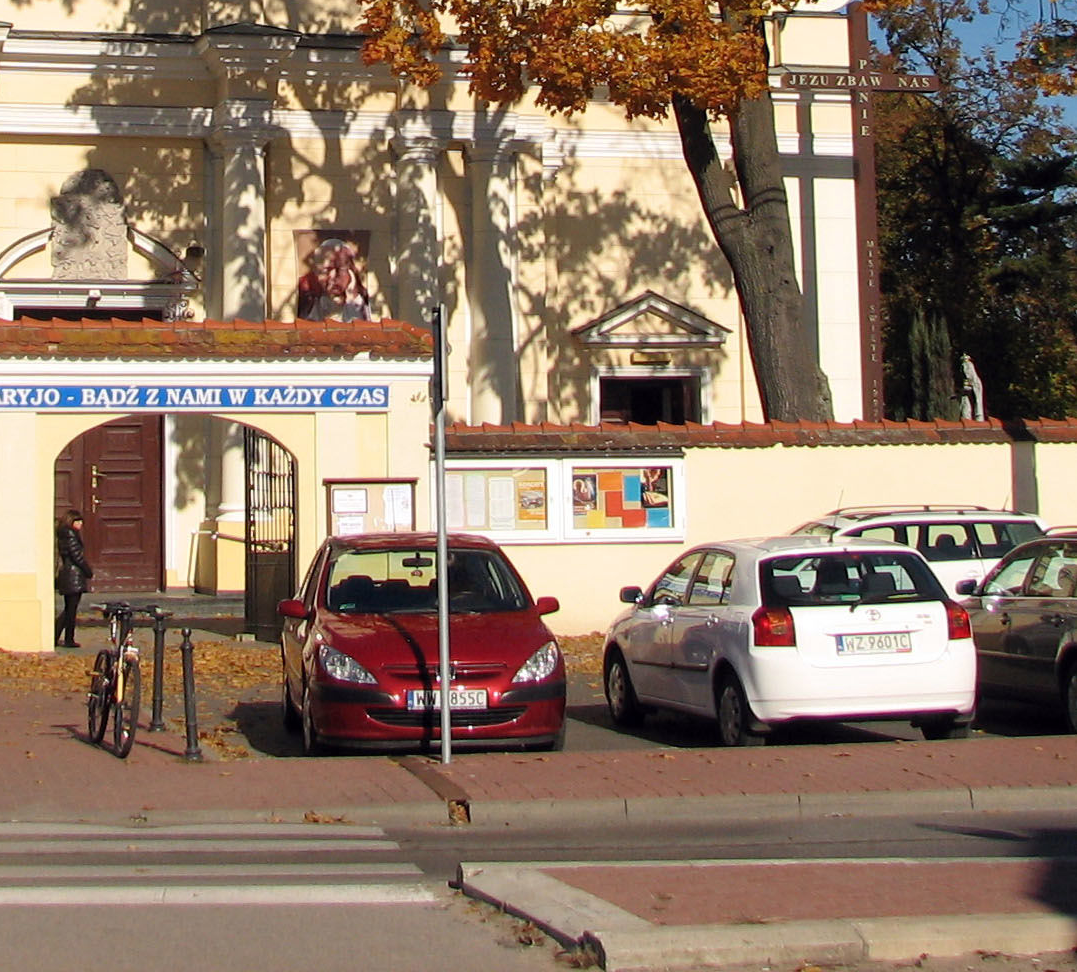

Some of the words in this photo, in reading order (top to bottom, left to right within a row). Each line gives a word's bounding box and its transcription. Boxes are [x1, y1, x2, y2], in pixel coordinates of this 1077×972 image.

[789, 74, 829, 86] JEZU
[836, 75, 883, 87] ZBAW
[898, 77, 931, 88] NAS
[81, 385, 140, 408] BĄDŹ
[146, 388, 160, 406] Z
[166, 388, 222, 406] NAMI
[227, 388, 248, 406] W
[253, 385, 327, 406] KAŻDY
[331, 388, 386, 406] CZAS
[844, 636, 865, 652] WZ
[868, 634, 908, 649] 9601C
[445, 691, 485, 706] 855C
